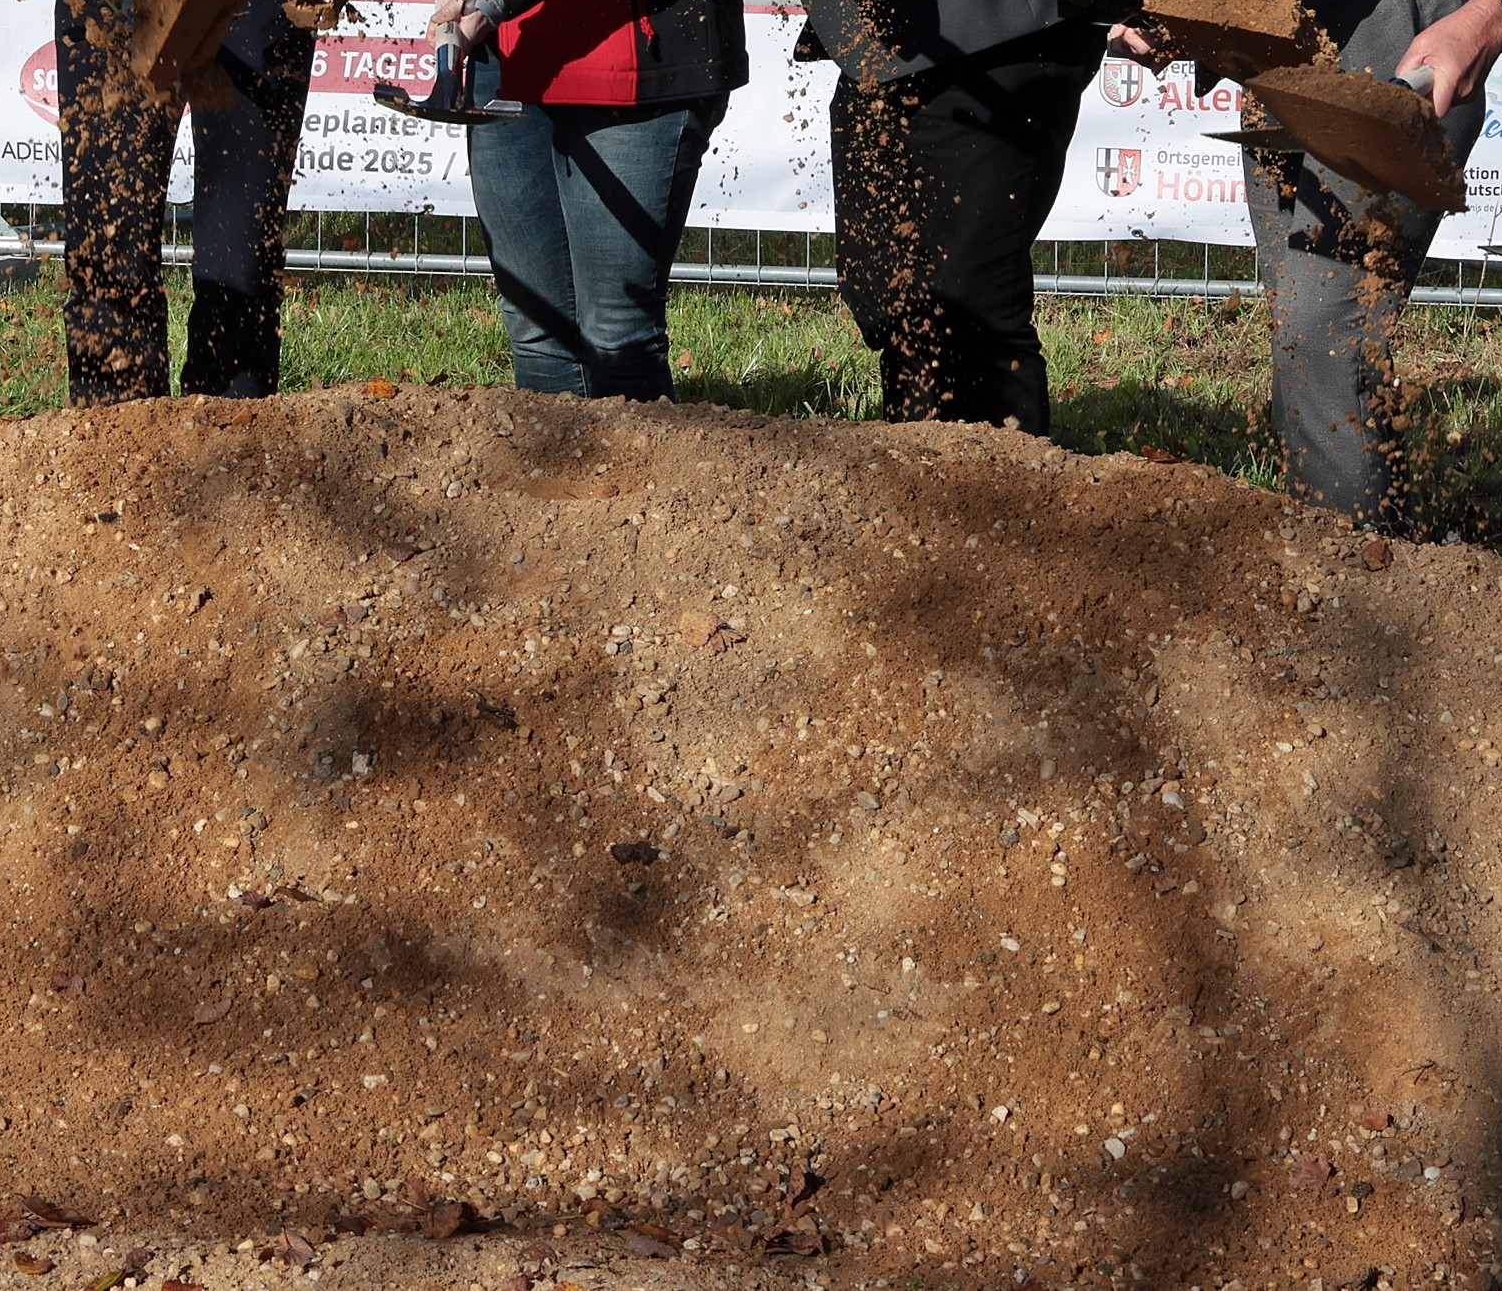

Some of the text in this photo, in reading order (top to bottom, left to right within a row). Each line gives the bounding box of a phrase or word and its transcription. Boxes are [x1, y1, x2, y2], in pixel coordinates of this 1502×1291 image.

[340, 50, 438, 82] TAGES
[304, 110, 419, 138] eplante
[1, 141, 61, 162] ADEN
[299, 145, 354, 172] nde
[364, 149, 433, 176] 2025
[1156, 150, 1241, 168] Ortsgemei
[1156, 169, 1248, 203] Hönn
